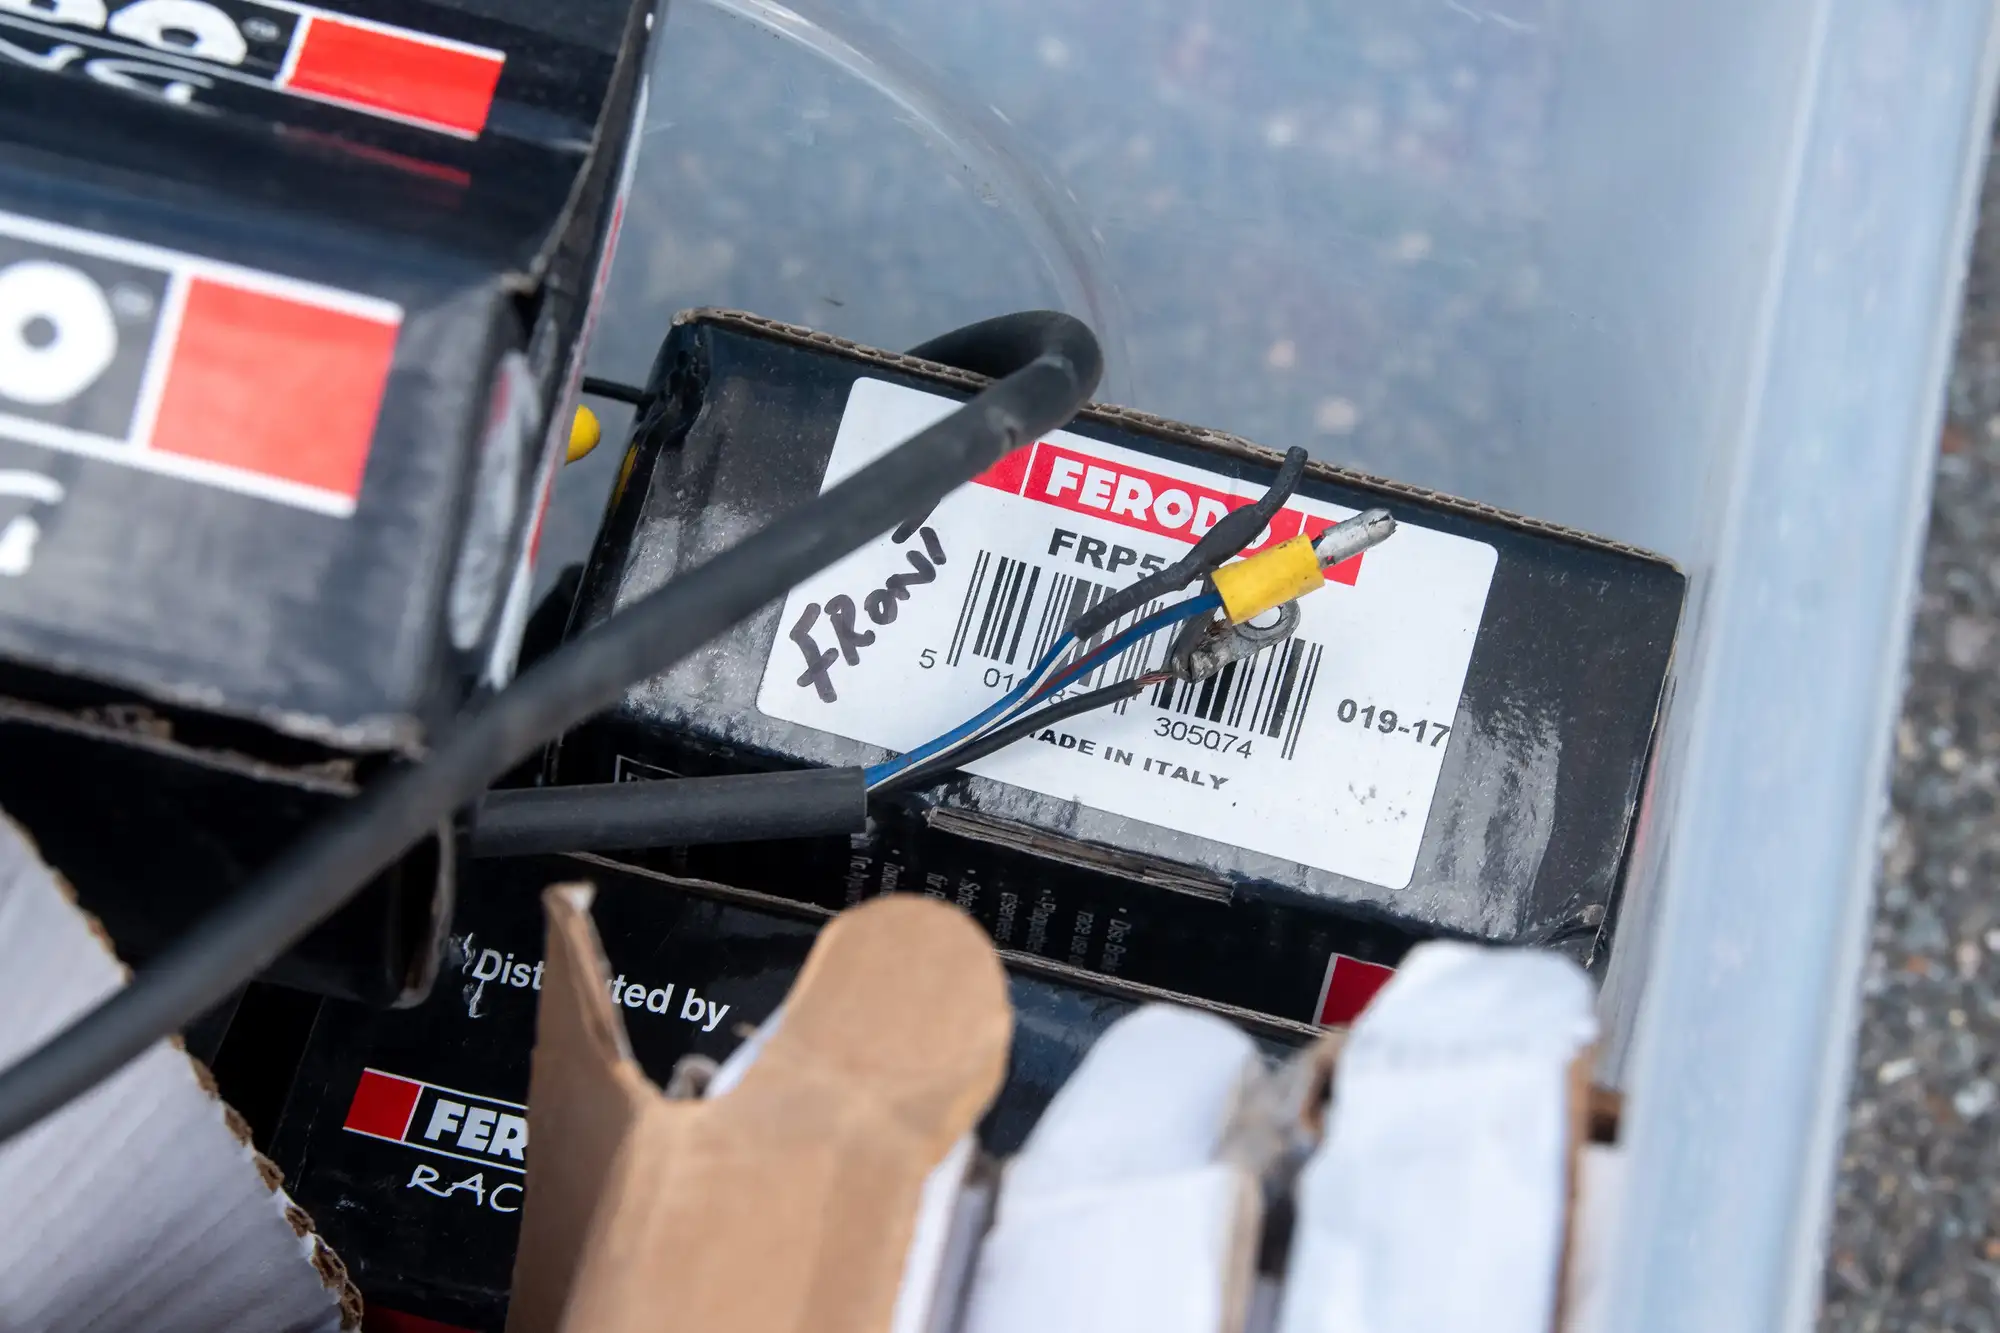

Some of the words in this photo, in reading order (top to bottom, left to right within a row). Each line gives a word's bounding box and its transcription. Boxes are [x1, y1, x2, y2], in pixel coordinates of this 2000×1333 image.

[1045, 456, 1272, 550] FEROD
[1038, 527, 1168, 580] FRP5
[918, 648, 938, 669] 5
[1154, 716, 1252, 759] 305074
[1337, 698, 1451, 748] 019-17
[1028, 728, 1097, 756] ADE
[1104, 746, 1134, 767] IN
[1143, 757, 1229, 790] ITALY
[472, 948, 675, 1015] Distted
[680, 988, 731, 1032] by
[424, 1098, 530, 1161] FER
[406, 1164, 524, 1213] RAC
